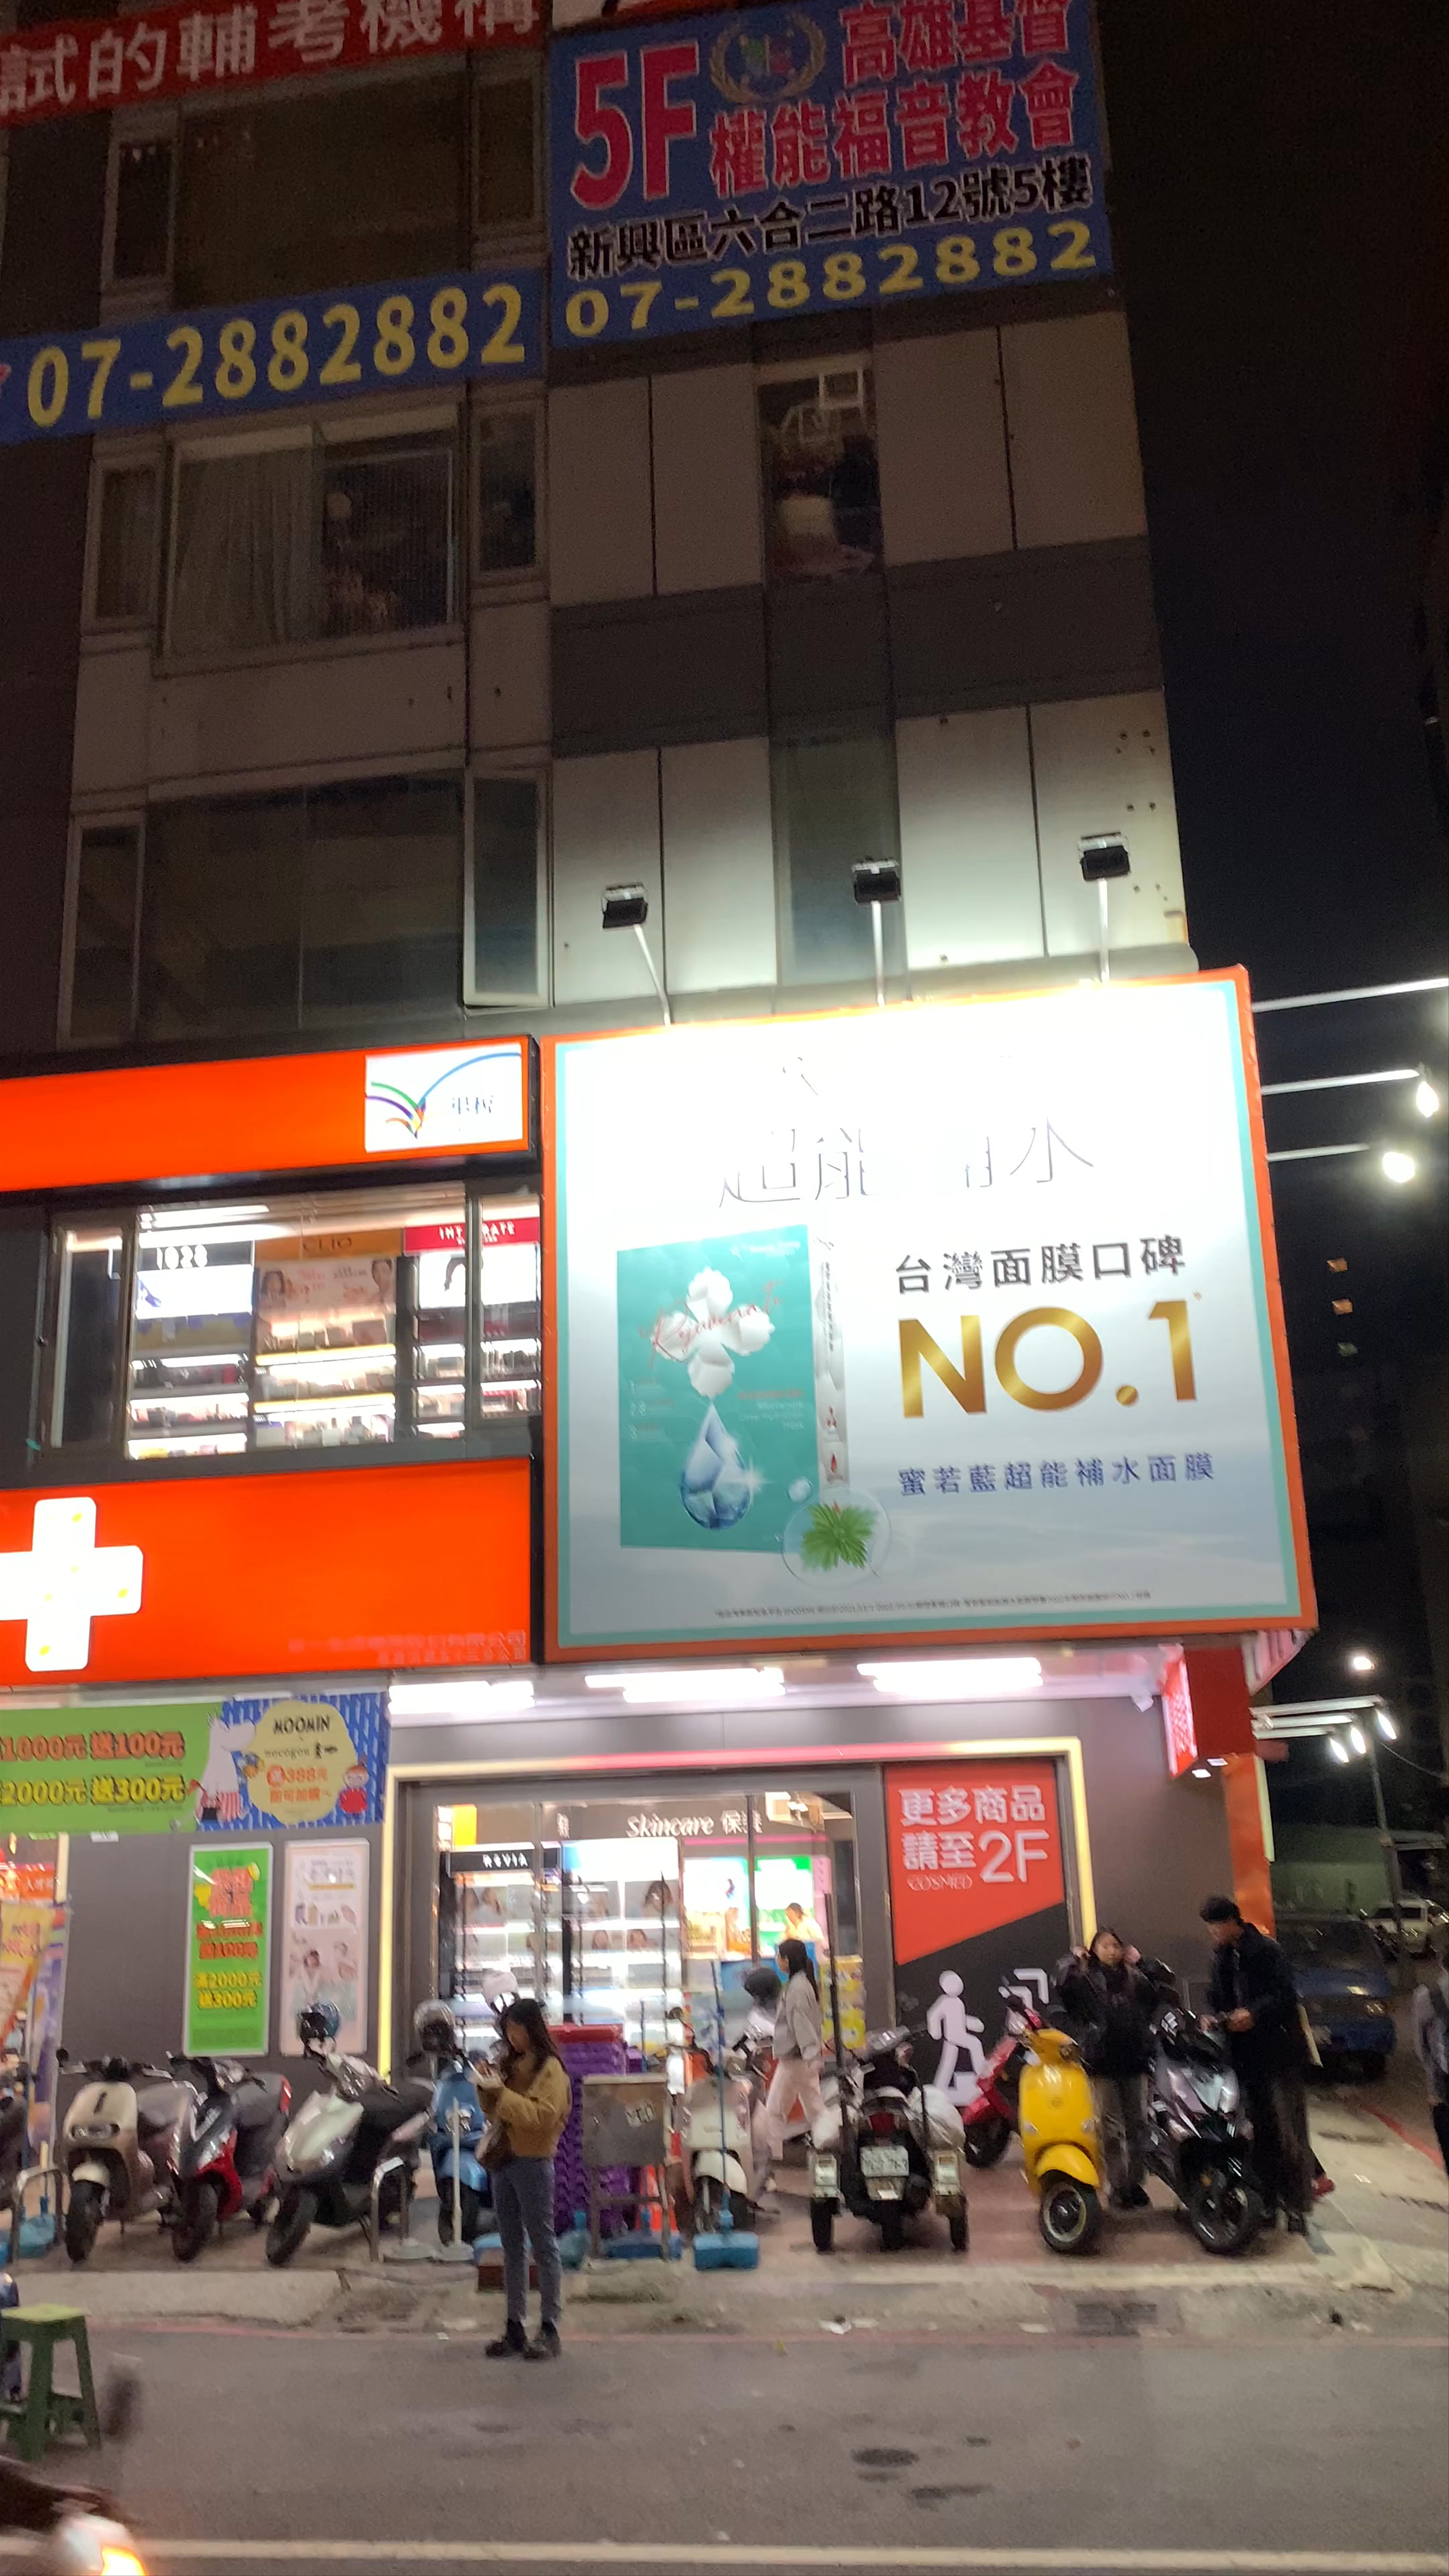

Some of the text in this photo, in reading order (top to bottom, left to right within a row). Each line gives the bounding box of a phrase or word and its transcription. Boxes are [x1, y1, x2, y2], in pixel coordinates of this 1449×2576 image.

[840, 0, 1070, 88] 高雄基督
[569, 40, 700, 211] 5F
[709, 58, 1080, 197] 權能福音教會
[567, 154, 1093, 280] 新興區六合二路12號5樓
[565, 220, 1097, 338] 07-2882882
[26, 283, 525, 427] 07-2882882
[156, 1244, 208, 1270] 1028
[439, 1221, 515, 1240] INTRATE
[895, 1235, 1186, 1295] 台灣面膜口碑
[897, 1300, 1198, 1419] NO.1
[898, 1451, 1214, 1496] 蜜若藍超能補水面膜
[626, 1813, 714, 1837] Skincare
[899, 1784, 1046, 1826] 更多商品
[901, 1829, 1049, 1884] 請至2F
